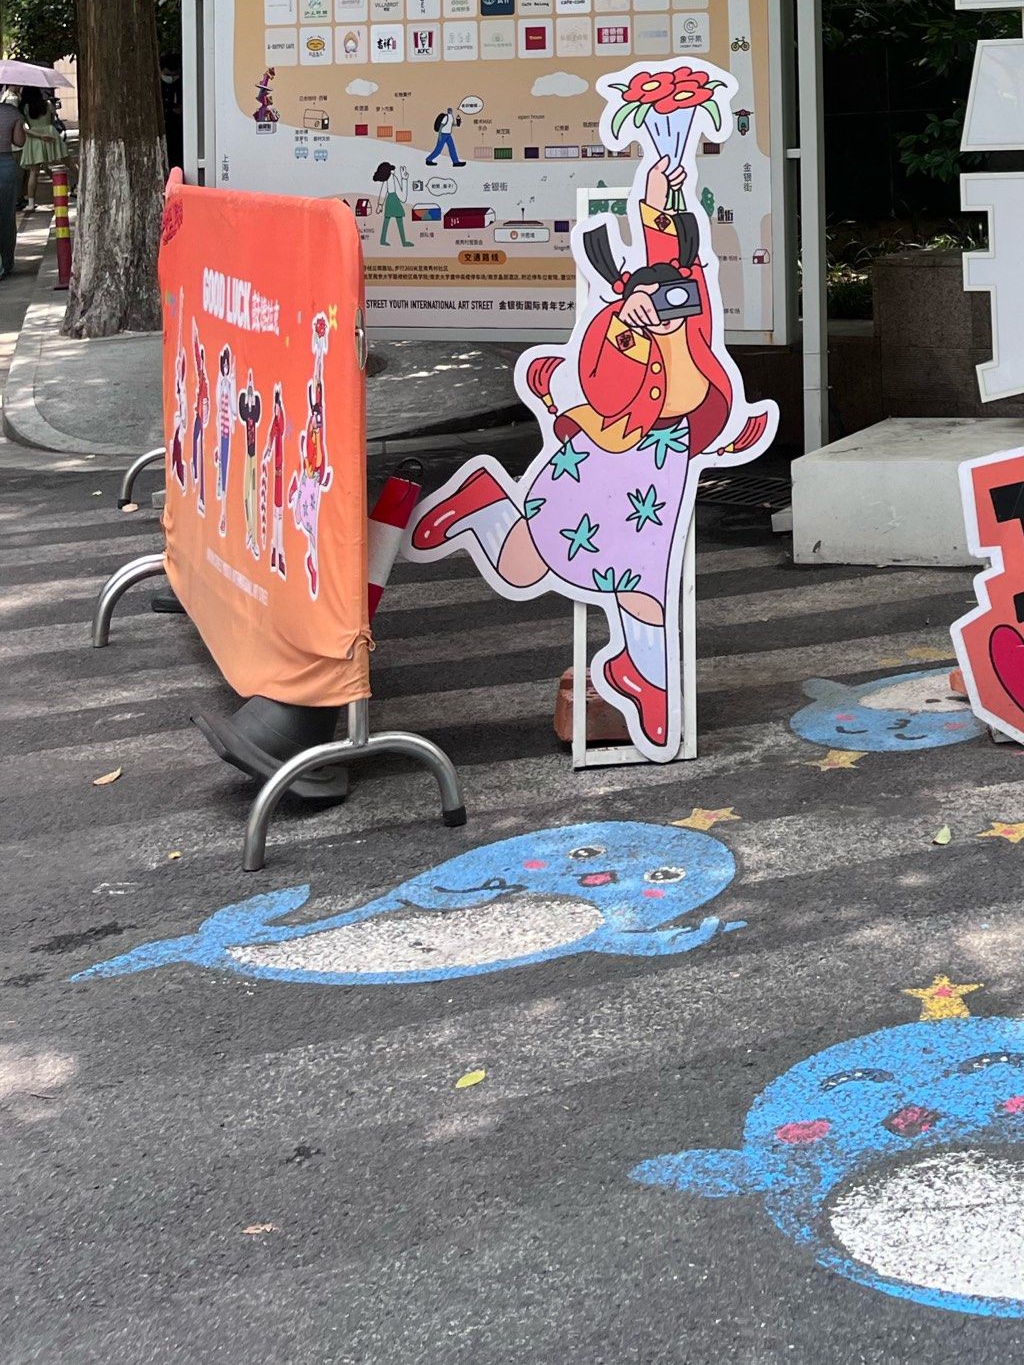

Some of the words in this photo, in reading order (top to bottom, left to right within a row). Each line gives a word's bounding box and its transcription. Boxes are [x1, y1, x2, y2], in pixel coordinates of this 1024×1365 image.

[742, 162, 752, 192] 金银街
[482, 182, 508, 192] 金银街
[464, 253, 500, 262] 交通路线
[203, 266, 226, 320] GOOD
[226, 275, 251, 331] LUCK
[366, 300, 387, 309] STREET
[389, 300, 409, 309] YOUTH
[410, 300, 456, 310] INTERNATIONAL
[457, 300, 470, 310] ART
[471, 300, 494, 310] STREET
